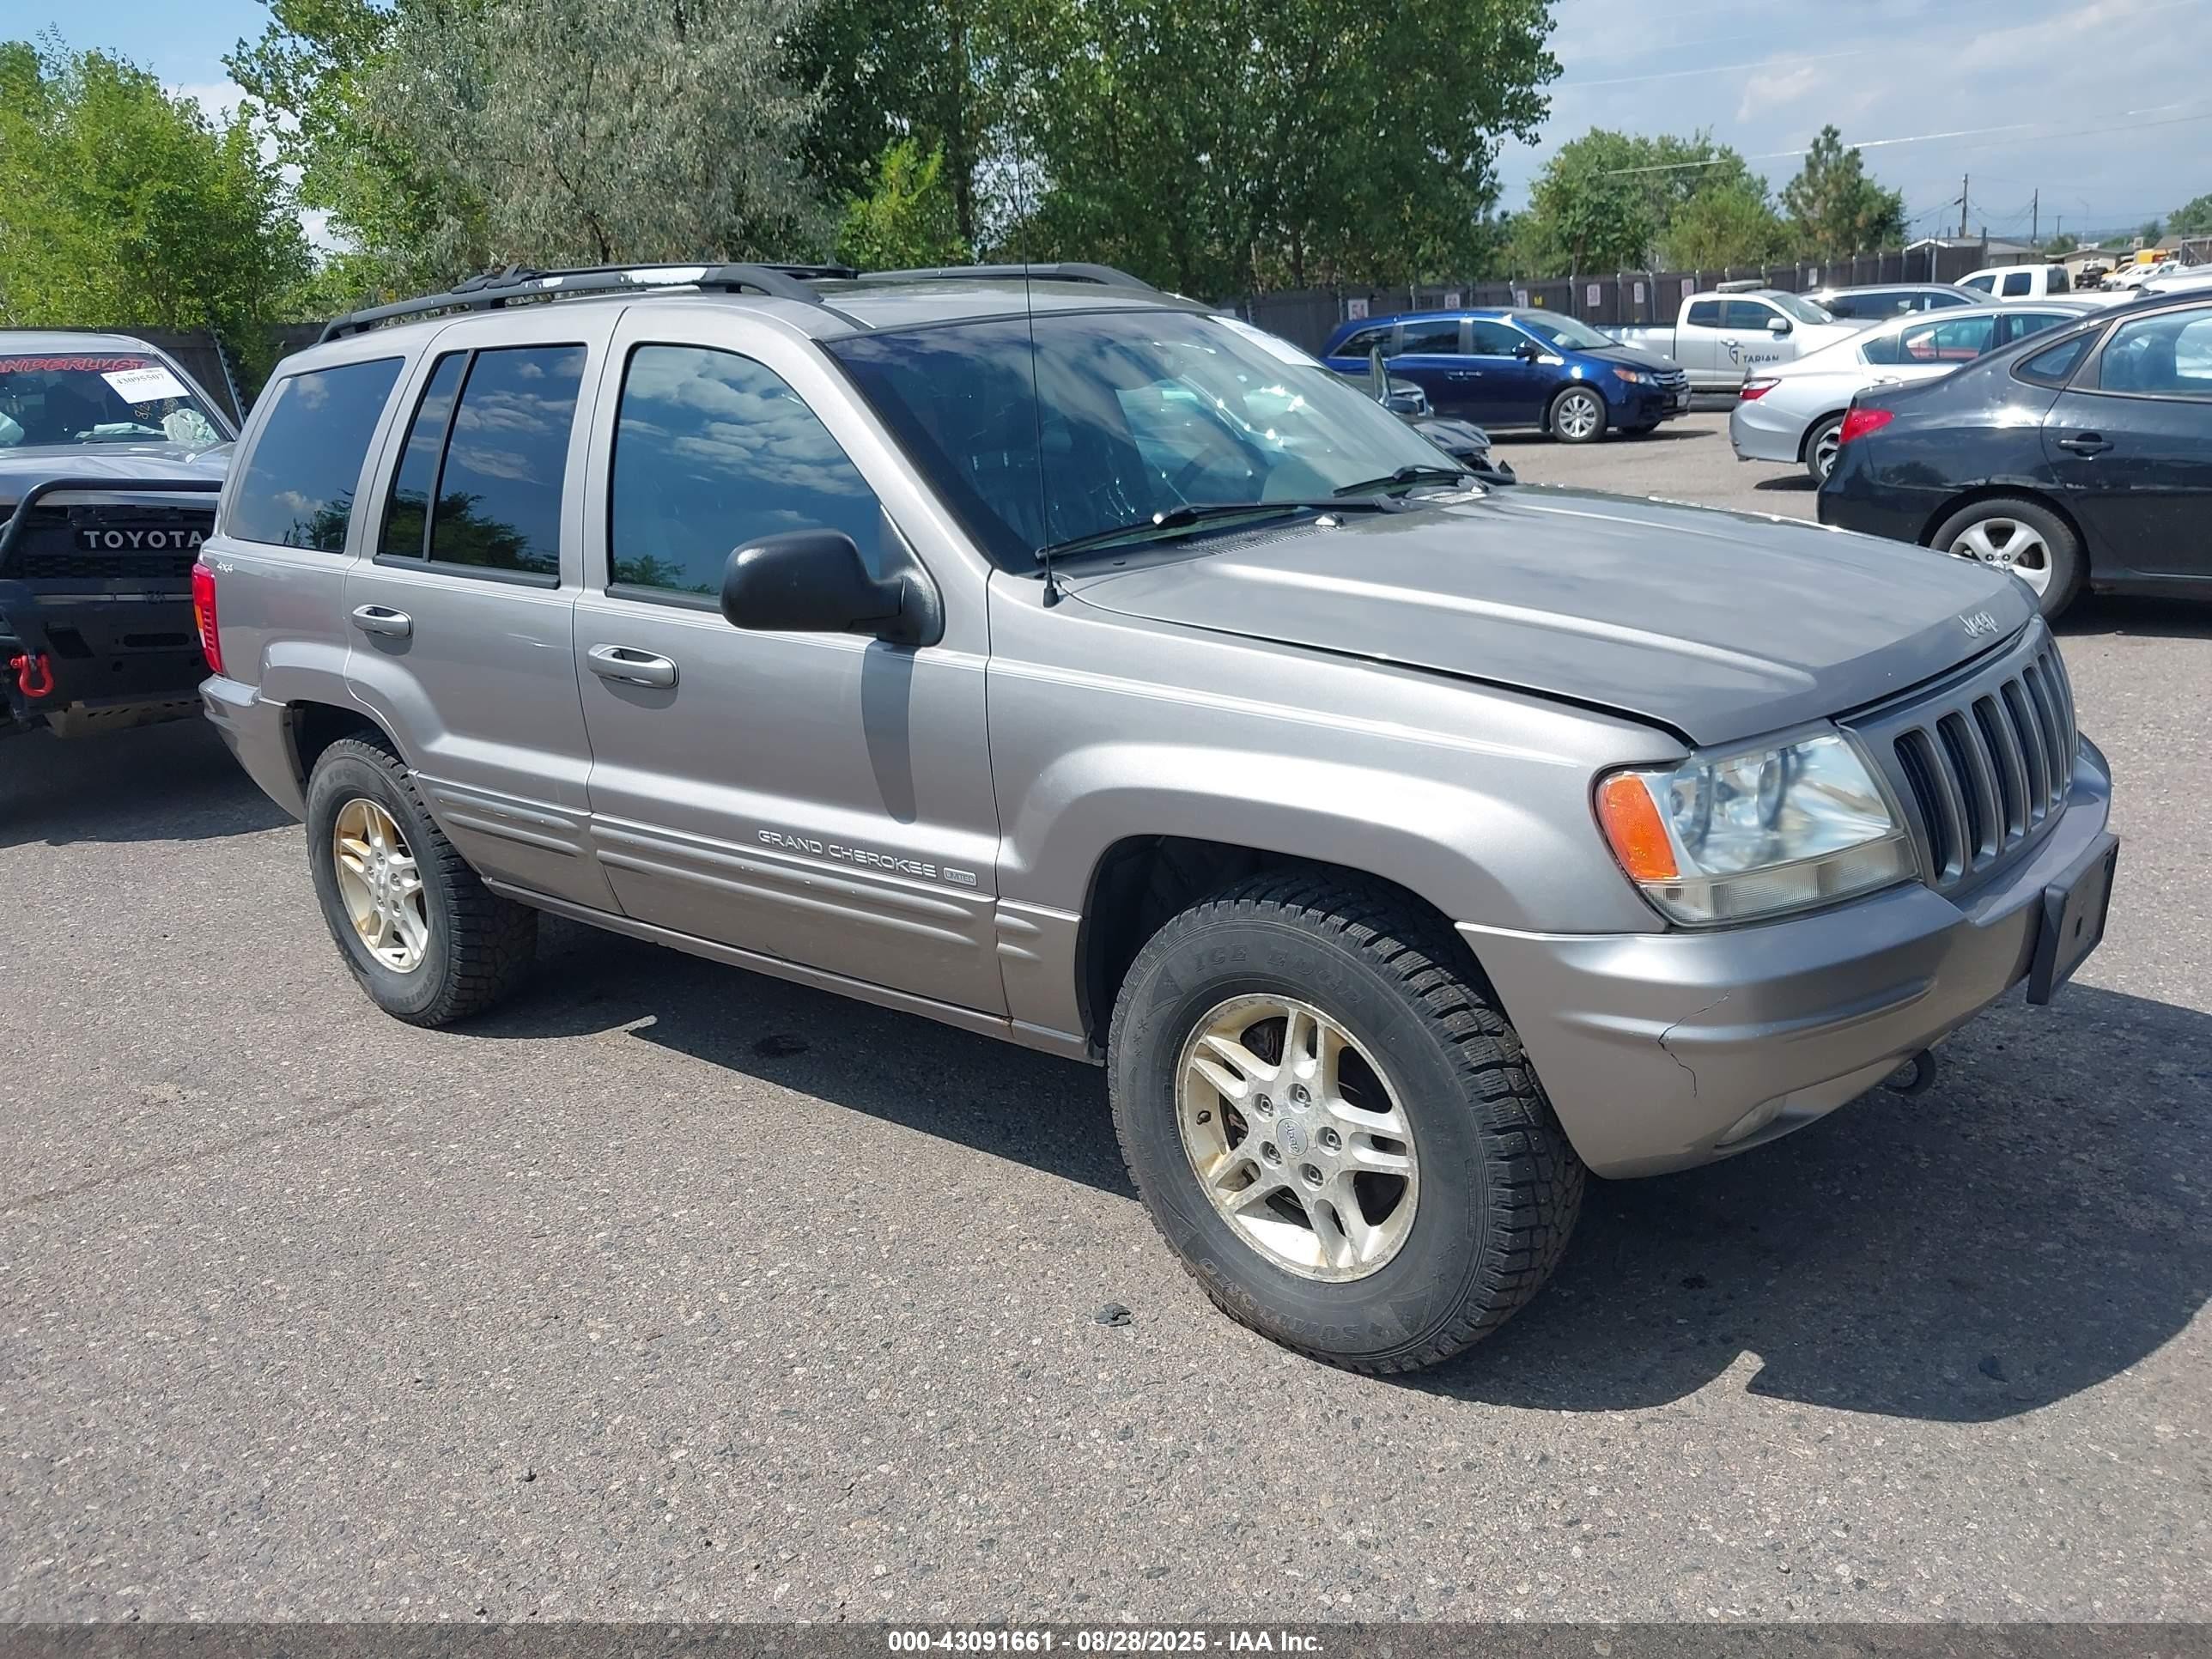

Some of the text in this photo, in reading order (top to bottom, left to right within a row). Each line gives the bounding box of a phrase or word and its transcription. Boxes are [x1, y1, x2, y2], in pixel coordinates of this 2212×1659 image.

[1743, 354, 1779, 363] TARIAN
[83, 531, 204, 548] TOYOTA
[1959, 611, 1998, 639] Jeep
[758, 830, 975, 884] GRAND CHEROKEE LIMITED
[1285, 1122, 1300, 1153] Jeep
